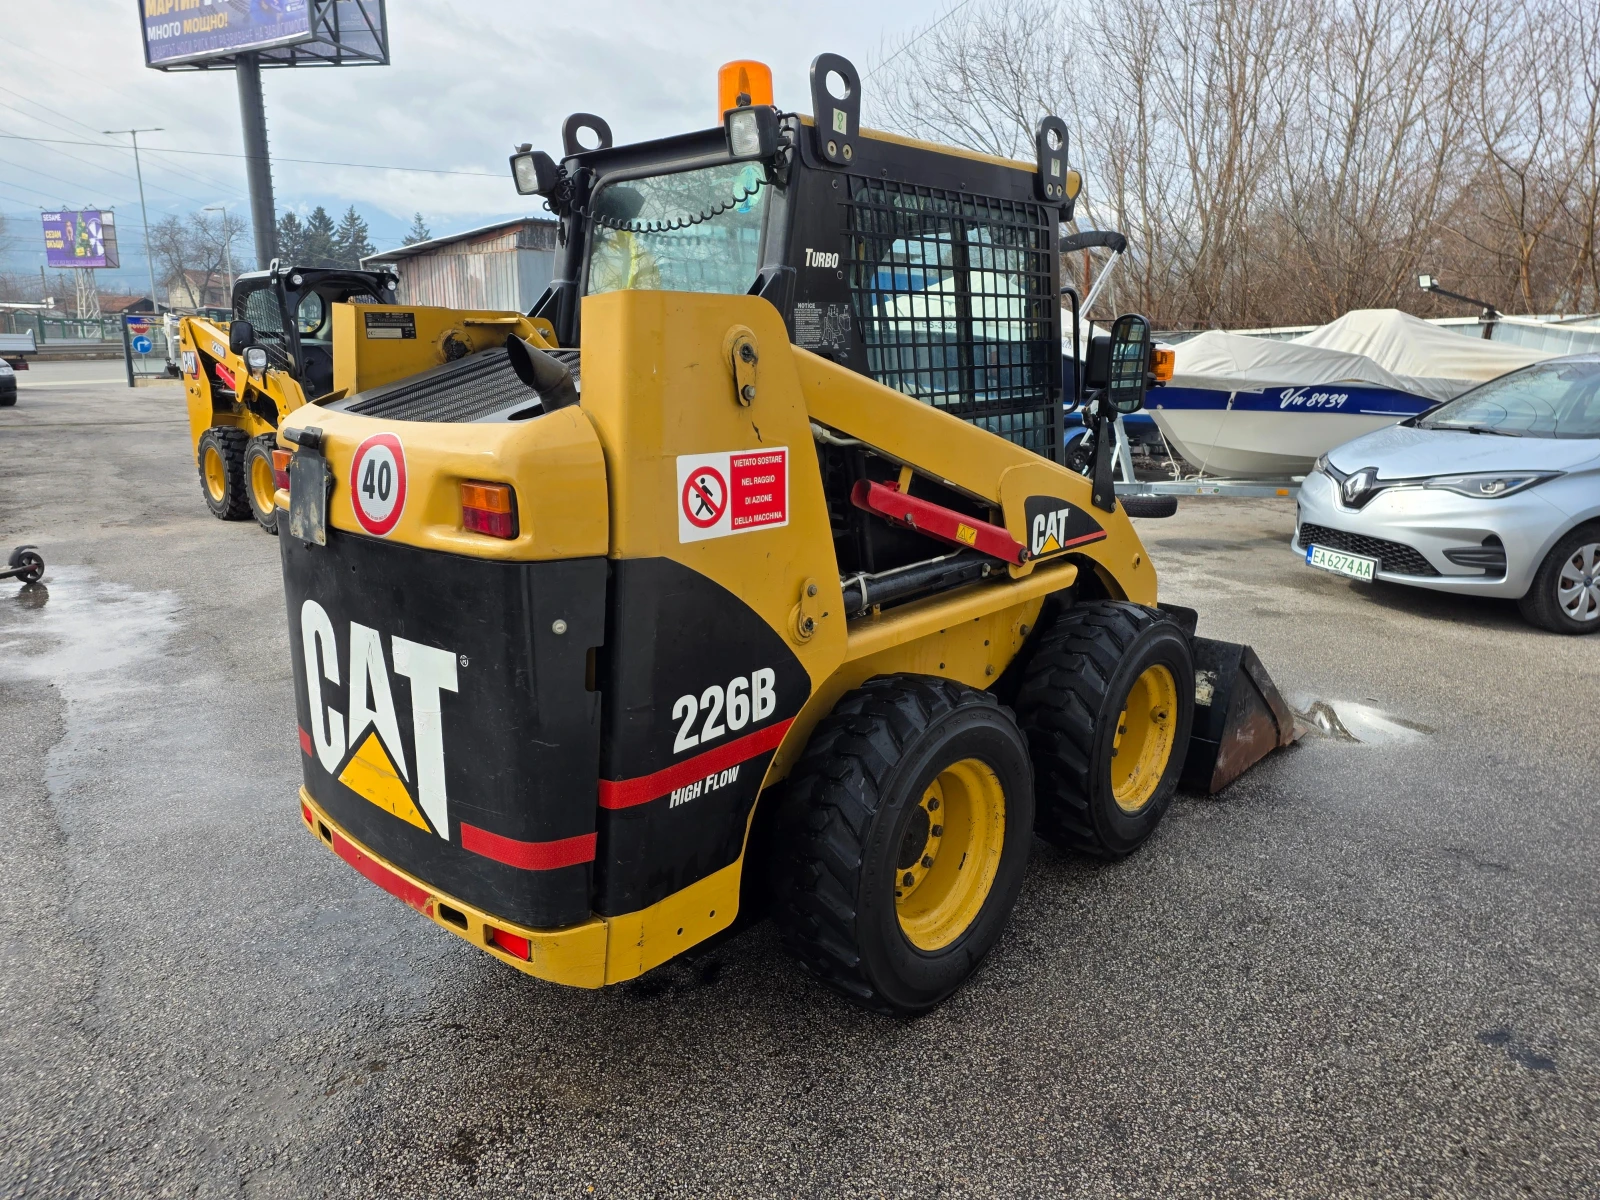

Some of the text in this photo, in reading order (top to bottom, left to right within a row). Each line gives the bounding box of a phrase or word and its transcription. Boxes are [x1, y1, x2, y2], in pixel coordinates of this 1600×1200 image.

[148, 12, 228, 41] МНОГО МОЩНО!
[805, 248, 839, 269] TURBO
[182, 351, 196, 374] CAT
[1306, 393, 1349, 409] 8939
[733, 455, 782, 468] VIETATO SOSTARE
[362, 458, 392, 502] 40
[741, 475, 776, 486] NEL RAGGIO
[745, 494, 772, 505] DI AZIONE
[734, 511, 782, 525] DELLA MACCHINA
[1032, 508, 1069, 556] CAT
[1313, 550, 1326, 566] EA
[1327, 554, 1354, 573] 6274
[1355, 561, 1371, 578] AA
[301, 599, 459, 842] CAT
[671, 667, 777, 755] 226B
[669, 765, 740, 809] HIGH FLOW
